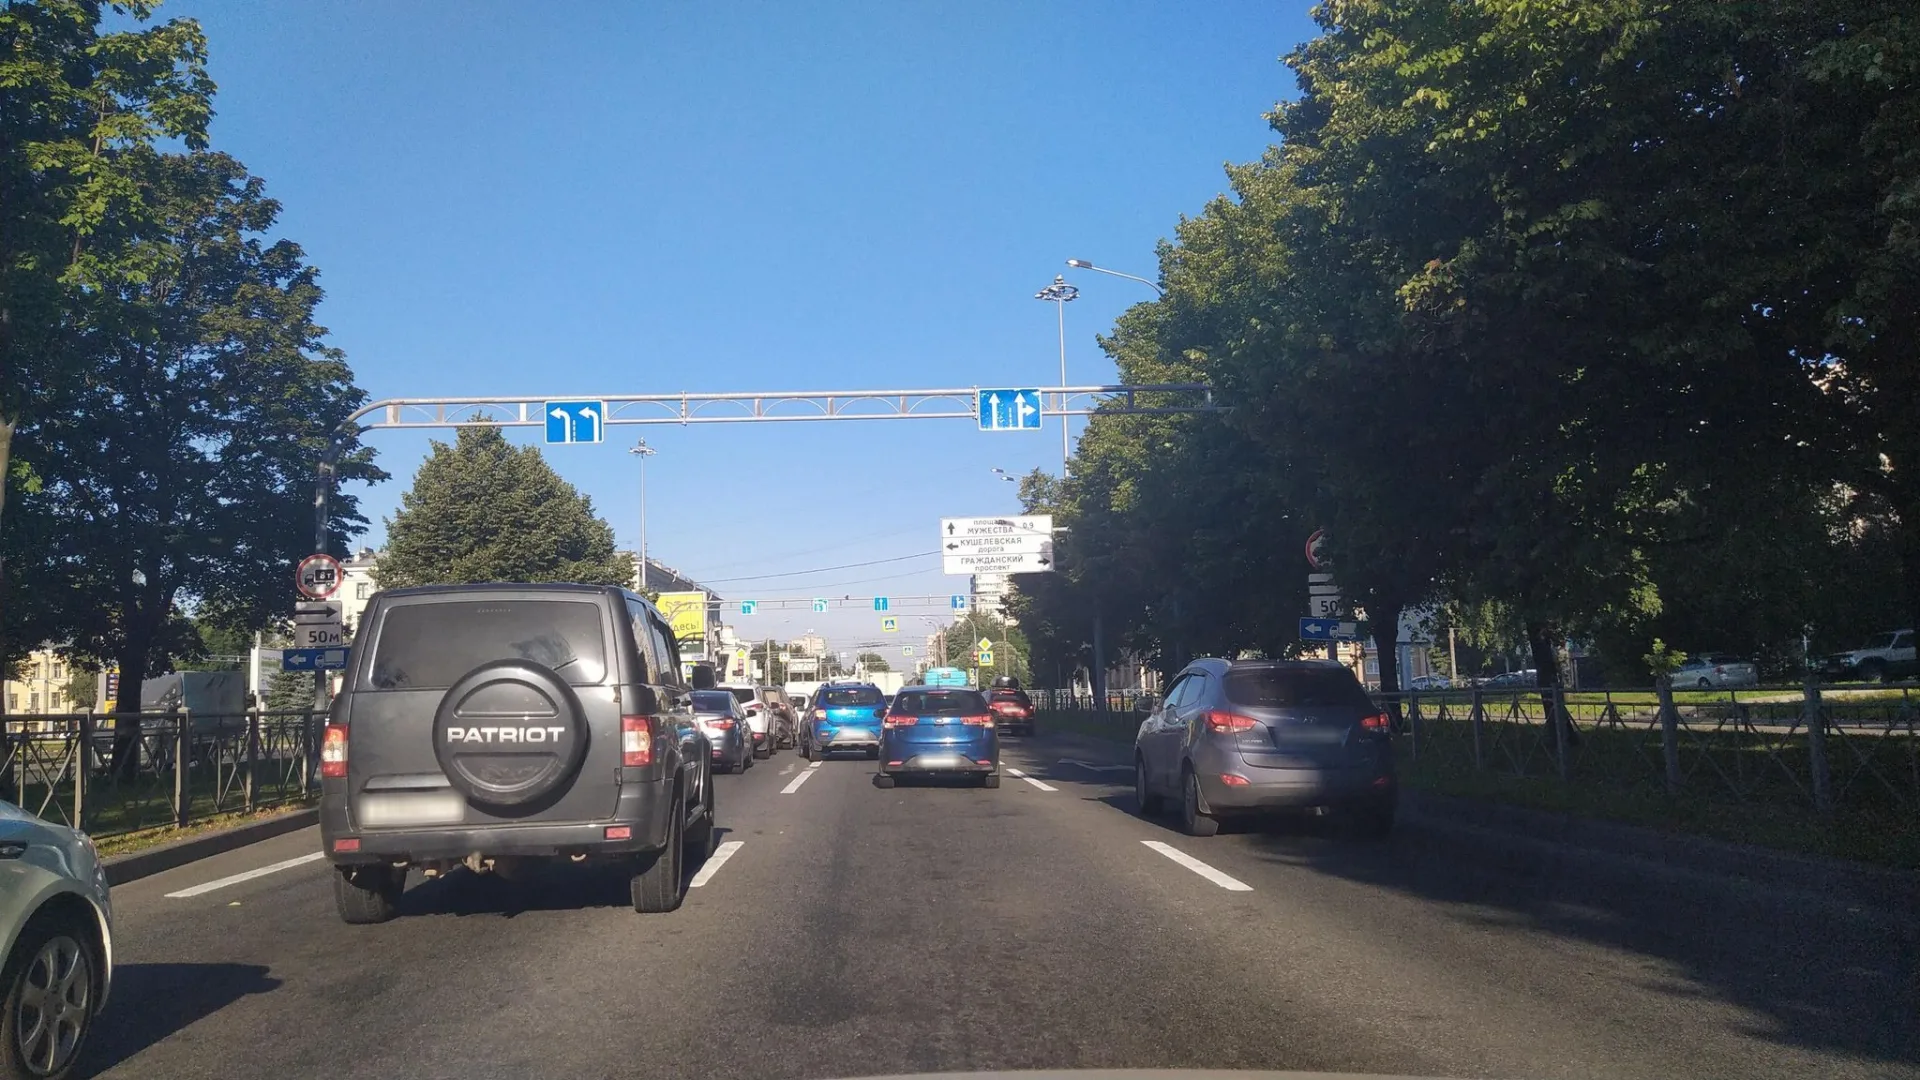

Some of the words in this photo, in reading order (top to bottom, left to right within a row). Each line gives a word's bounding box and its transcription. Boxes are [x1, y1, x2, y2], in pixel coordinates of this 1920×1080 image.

[967, 526, 1014, 535] МУЖЕСТВА
[960, 537, 1022, 547] КУШЕЛЕВСКАЯ
[960, 554, 1024, 565] ГРАЖДАНСКИЙ
[975, 564, 1011, 573] проспект
[1320, 600, 1339, 613] 50
[673, 621, 700, 632] десь!
[308, 630, 340, 643] 50м
[447, 727, 565, 743] PATRIOT
